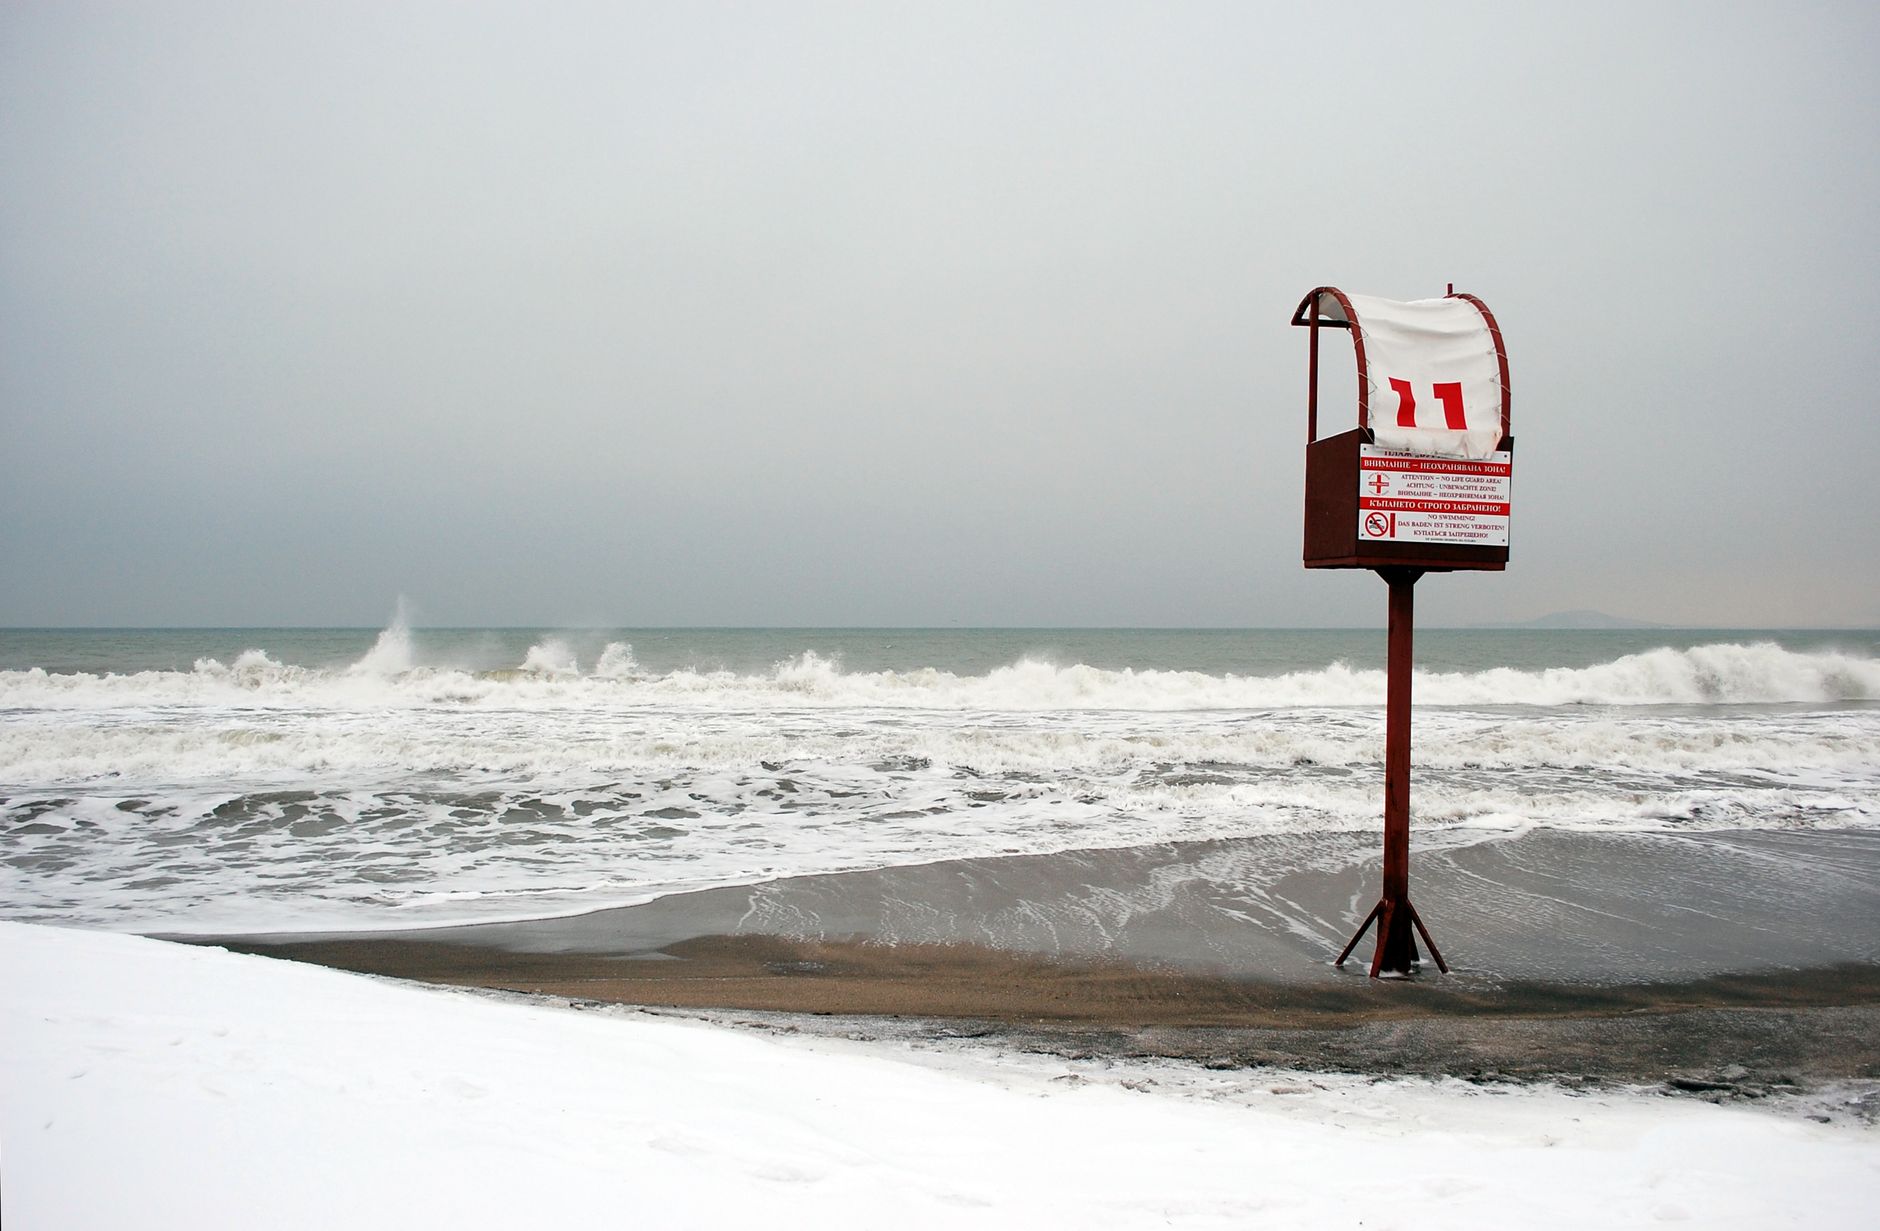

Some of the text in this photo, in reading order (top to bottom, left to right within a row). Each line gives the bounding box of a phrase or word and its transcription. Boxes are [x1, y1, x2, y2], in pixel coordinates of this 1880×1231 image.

[1388, 377, 1467, 430] 11
[1364, 460, 1410, 468] ВНИМАНИЕ
[1369, 500, 1416, 508] КЪПАНЕТО
[1453, 504, 1501, 512] ЗАБРАНЕНО!
